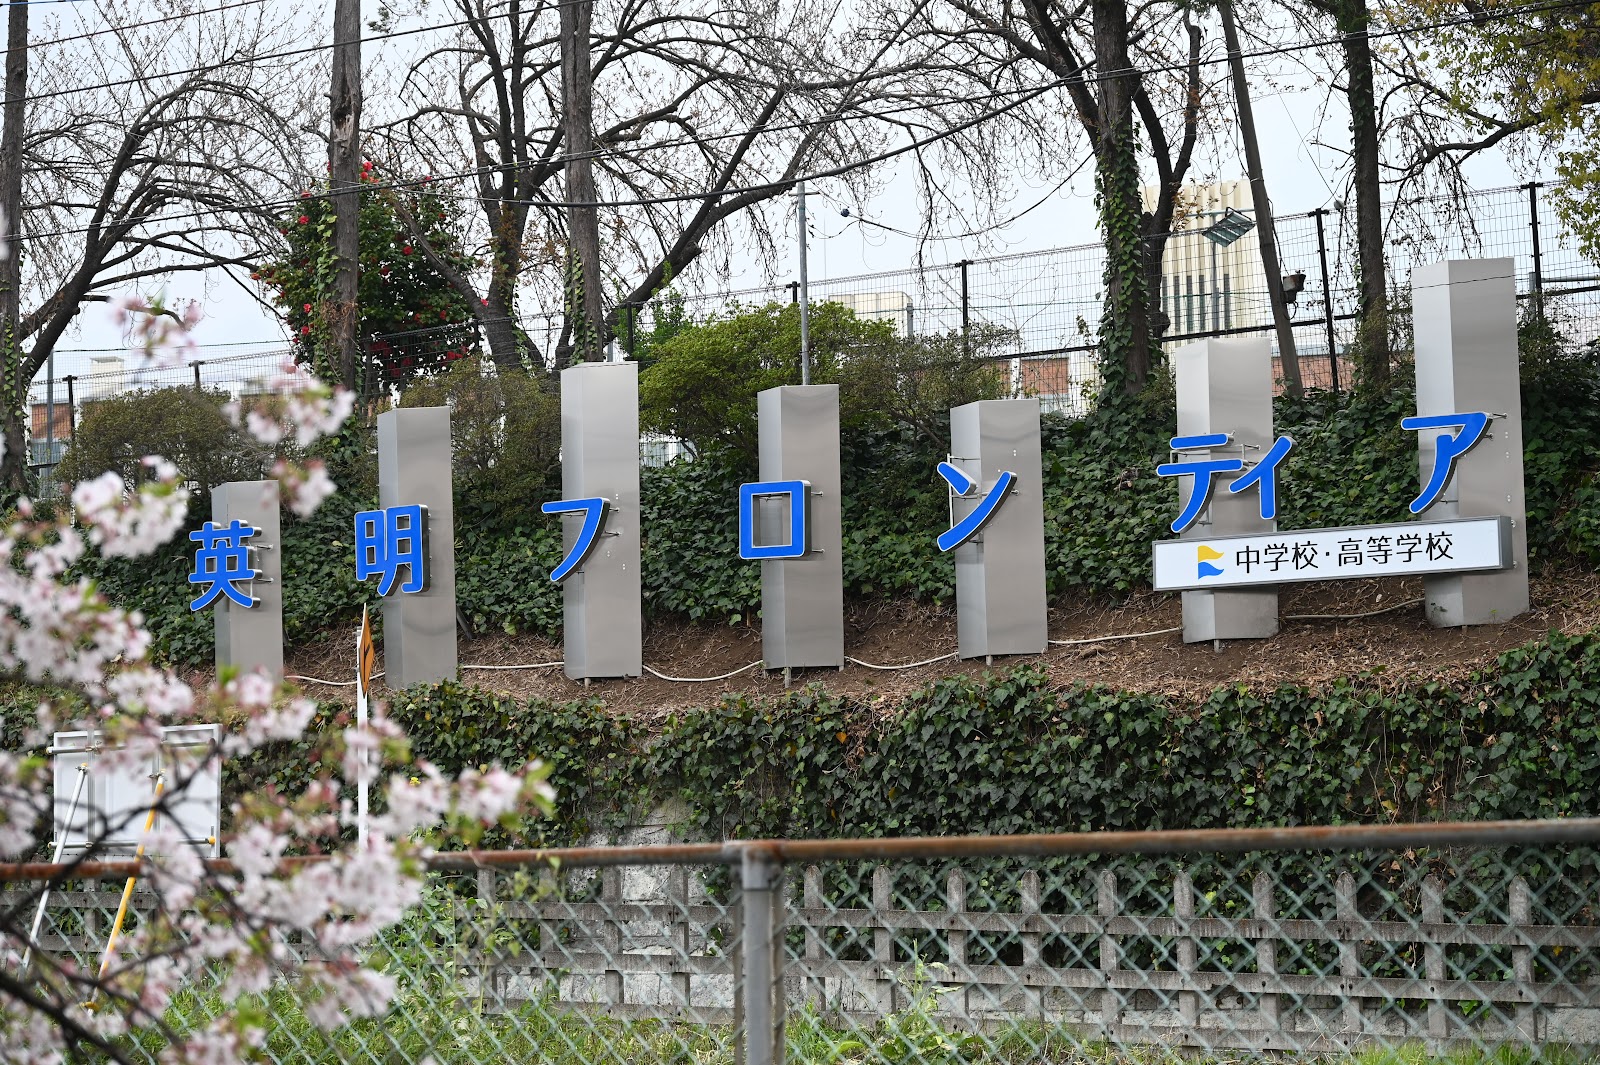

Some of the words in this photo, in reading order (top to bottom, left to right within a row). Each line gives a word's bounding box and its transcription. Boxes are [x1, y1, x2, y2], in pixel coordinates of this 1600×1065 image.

[1235, 530, 1454, 574] 中学校・高等学校
